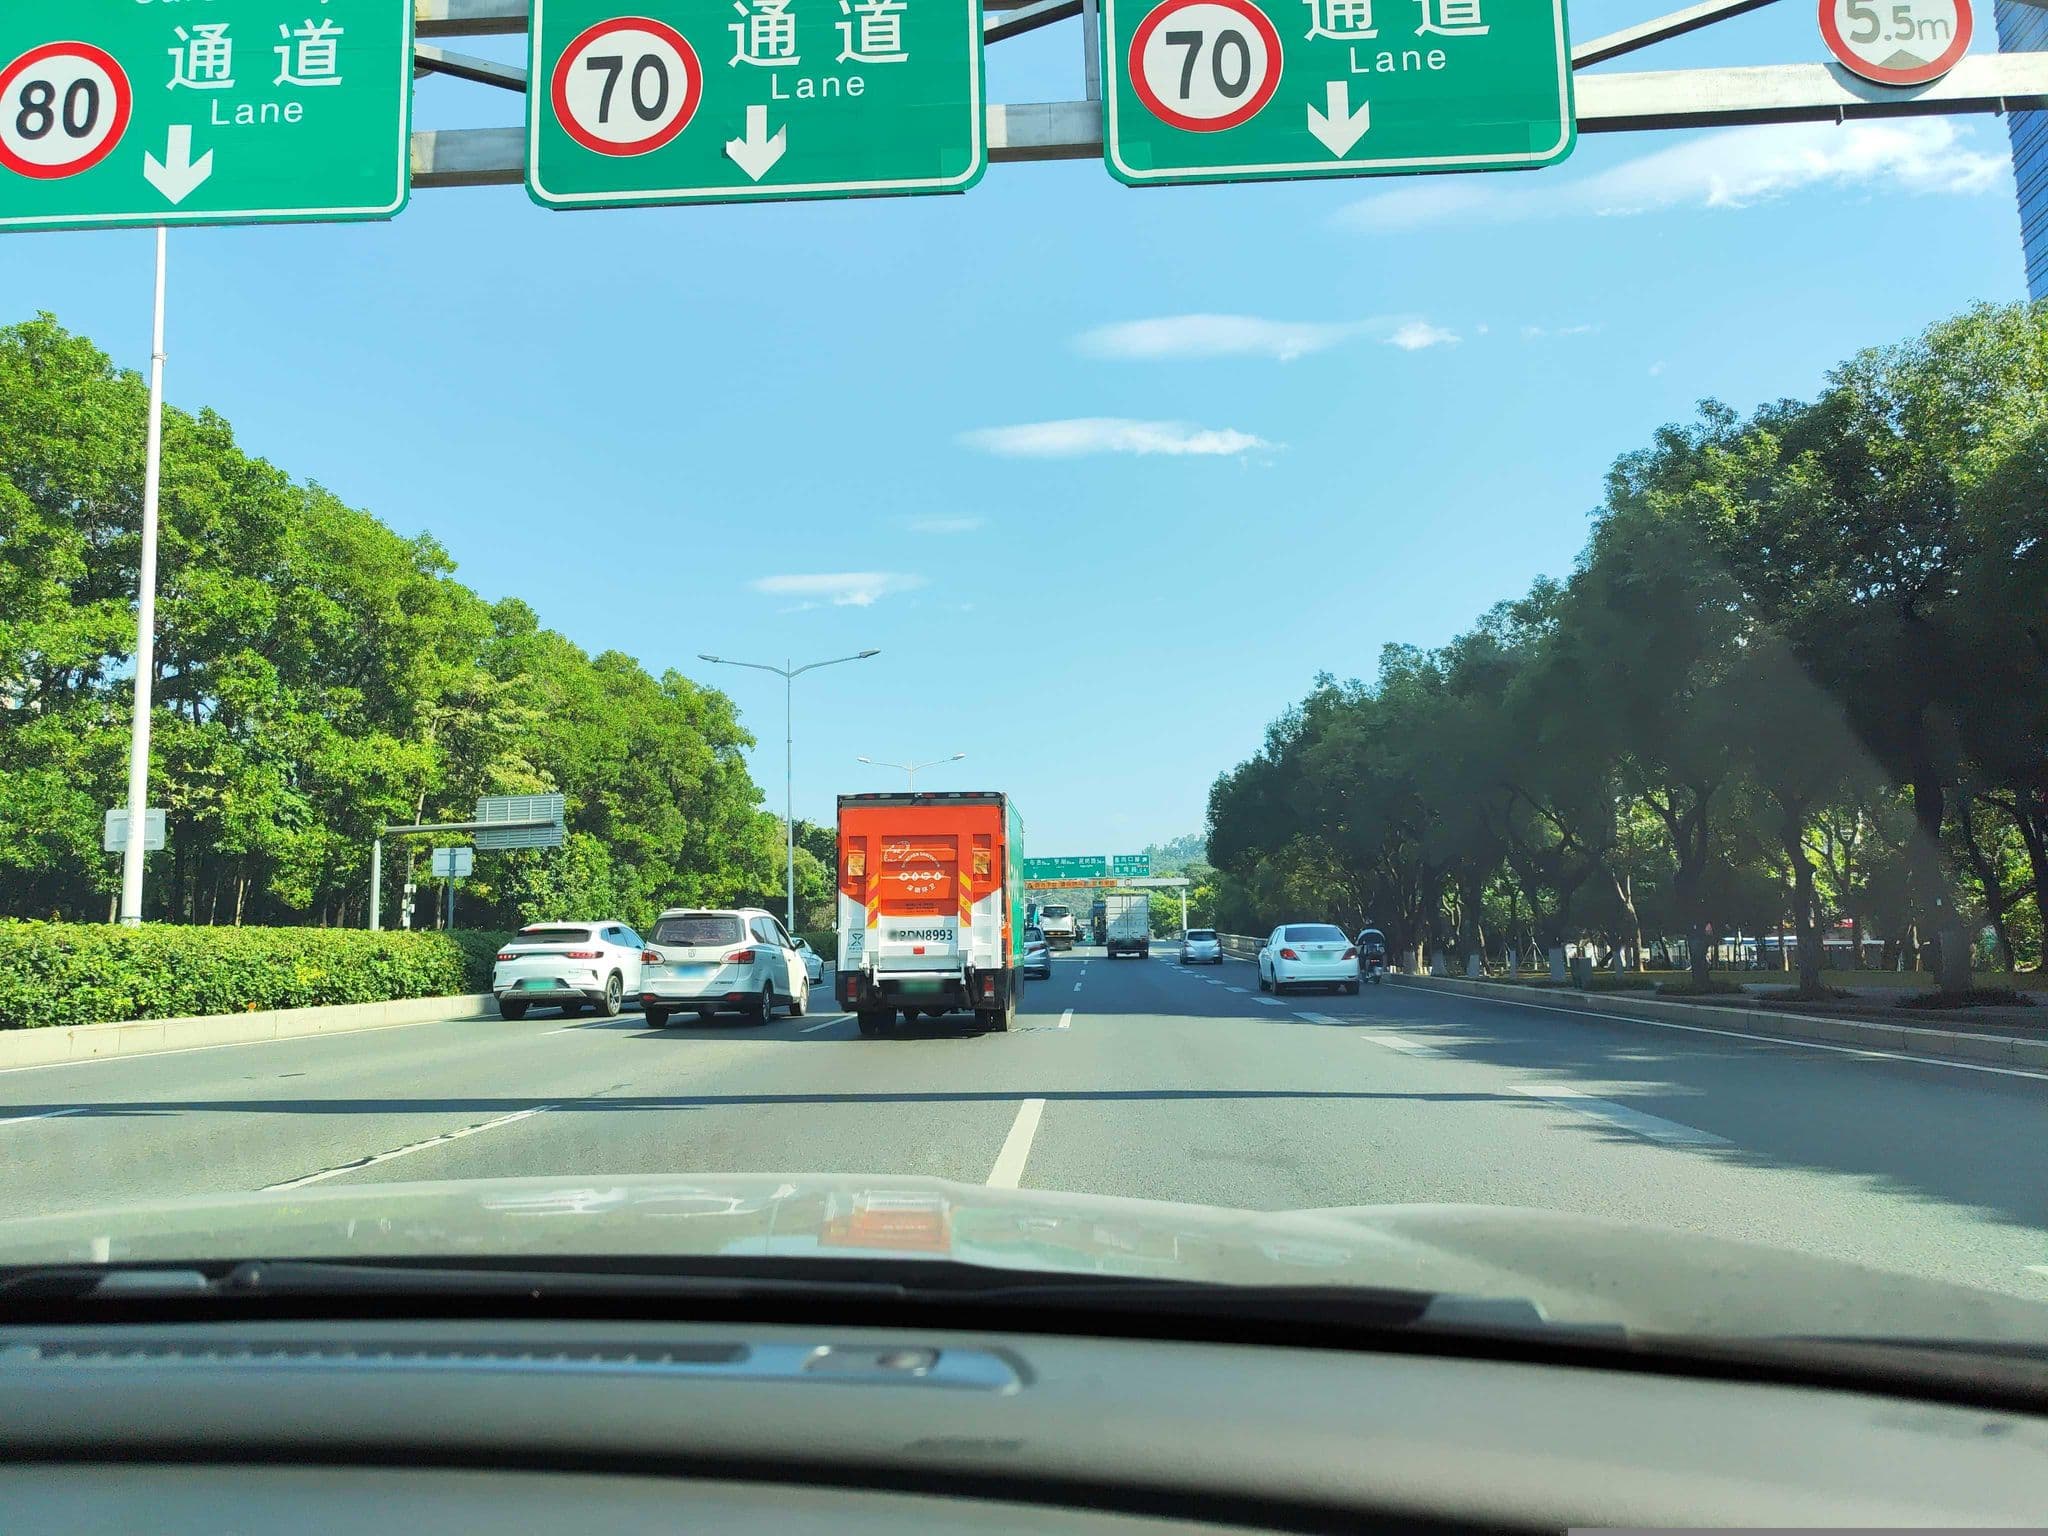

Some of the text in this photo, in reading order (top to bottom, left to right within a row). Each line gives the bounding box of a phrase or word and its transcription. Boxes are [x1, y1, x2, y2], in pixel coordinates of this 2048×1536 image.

[727, 0, 909, 68] 通道
[1847, 0, 1950, 44] 5.5m
[165, 18, 345, 93] 通道
[771, 73, 866, 100] Lane
[1165, 30, 1251, 99] 70
[1350, 47, 1446, 74] Lane
[15, 78, 100, 141] 80
[211, 99, 304, 126] Lane
[586, 54, 669, 124] 70
